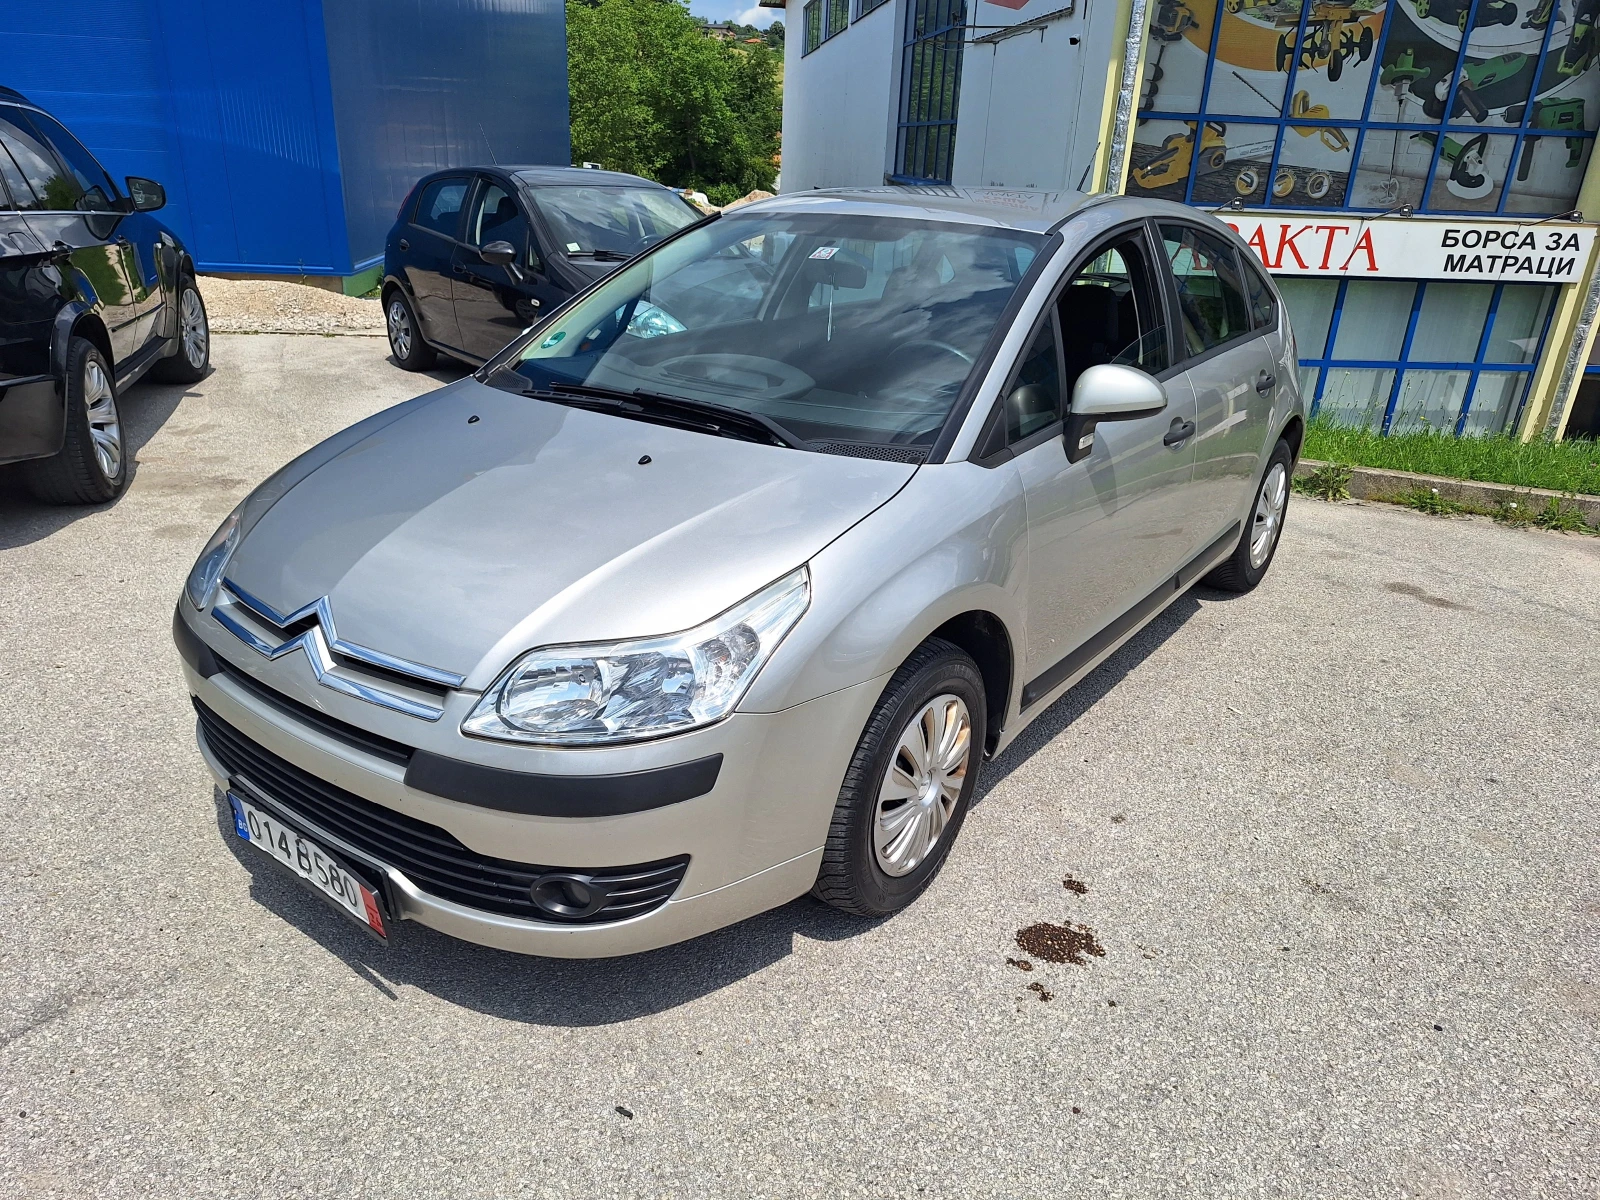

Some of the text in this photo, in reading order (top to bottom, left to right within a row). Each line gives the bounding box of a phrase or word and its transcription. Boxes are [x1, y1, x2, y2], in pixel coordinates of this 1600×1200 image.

[1441, 229, 1580, 252] БОРСА ЗА
[1443, 254, 1575, 277] МАТРАЦИ
